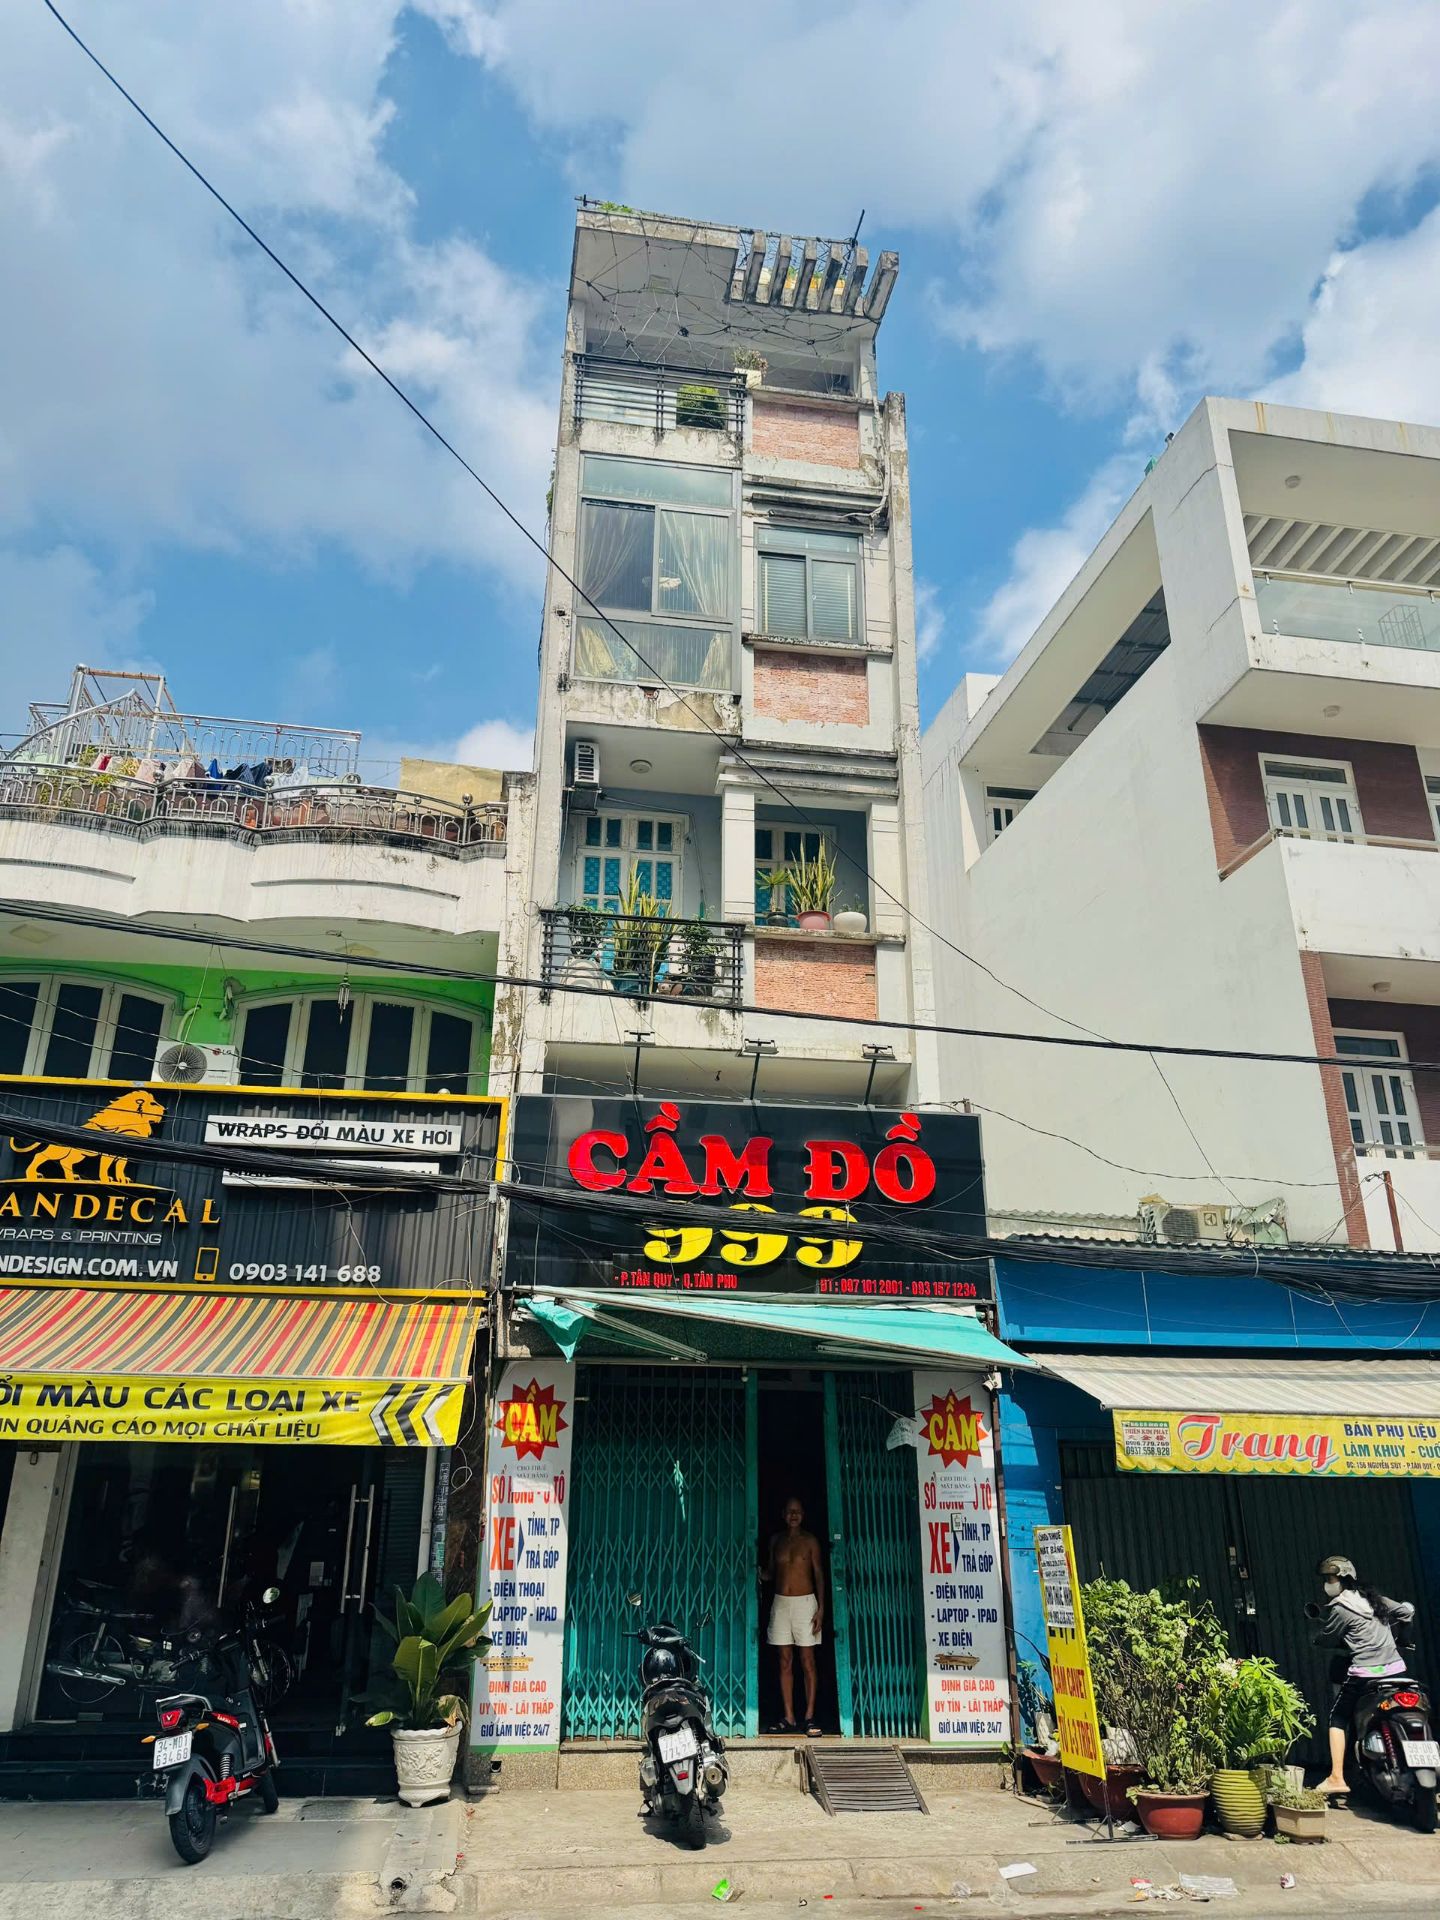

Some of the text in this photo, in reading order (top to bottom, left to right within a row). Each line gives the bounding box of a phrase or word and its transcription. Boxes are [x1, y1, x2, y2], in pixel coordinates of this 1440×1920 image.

[217, 1120, 452, 1145] WRAPS ĐỔI MÀU XE HƠI
[567, 1102, 937, 1204] CẦM ĐỒ
[0, 1228, 162, 1244] RAPS & PRINTING
[229, 1263, 381, 1283] 0903 141 688
[952, 1282, 977, 1297] 1234
[36, 1380, 130, 1409] MÀU
[144, 1382, 213, 1410] CÁC
[226, 1388, 306, 1417] LOẠI
[319, 1390, 362, 1413] XE
[505, 1385, 557, 1443] CẦM
[929, 1398, 979, 1451] CẦM
[26, 1414, 104, 1435] QUẢNG
[111, 1416, 157, 1436] CÁO
[163, 1421, 207, 1439] MỌI
[213, 1417, 270, 1438] CHẤT
[275, 1418, 320, 1441] LIỆU
[1344, 1421, 1437, 1441] BÁN PHỤ LIỆU
[1177, 1414, 1340, 1473] Trang
[1373, 1444, 1405, 1458] KHUY
[527, 1511, 560, 1538] TỈNH, TP
[982, 1523, 991, 1541] TP
[490, 1517, 516, 1571] XE
[928, 1522, 952, 1573] XE
[526, 1544, 559, 1569] TRẢ GÓP
[961, 1549, 994, 1573] TRẢ GÓP
[493, 1579, 515, 1600] ĐIỆN
[518, 1582, 545, 1600] THOẠI
[936, 1582, 956, 1602] ĐIỆN
[958, 1585, 984, 1603] THOẠI
[492, 1606, 527, 1622] LAPTOP
[536, 1606, 557, 1622] IPAD
[937, 1608, 969, 1623] LAPTOP
[978, 1608, 998, 1623] IPAD
[491, 1628, 528, 1650] XE ĐIỆN
[938, 1632, 950, 1647] XE
[952, 1628, 973, 1650] ĐIỆN
[488, 1680, 510, 1696] ĐỊNH
[529, 1680, 547, 1693] CAO
[941, 1680, 961, 1694] ĐỊNH
[979, 1680, 995, 1692] CAO
[479, 1703, 491, 1715] UY
[531, 1697, 554, 1715] THẤP
[934, 1701, 945, 1713] UY
[983, 1696, 1004, 1712] THẤP
[496, 1721, 512, 1737] LÀM
[515, 1721, 531, 1739] VIỆC
[533, 1723, 550, 1737] 24/7
[952, 1719, 968, 1734] LÀM
[969, 1718, 985, 1736] VIỆC
[987, 1721, 1002, 1734] 24/7
